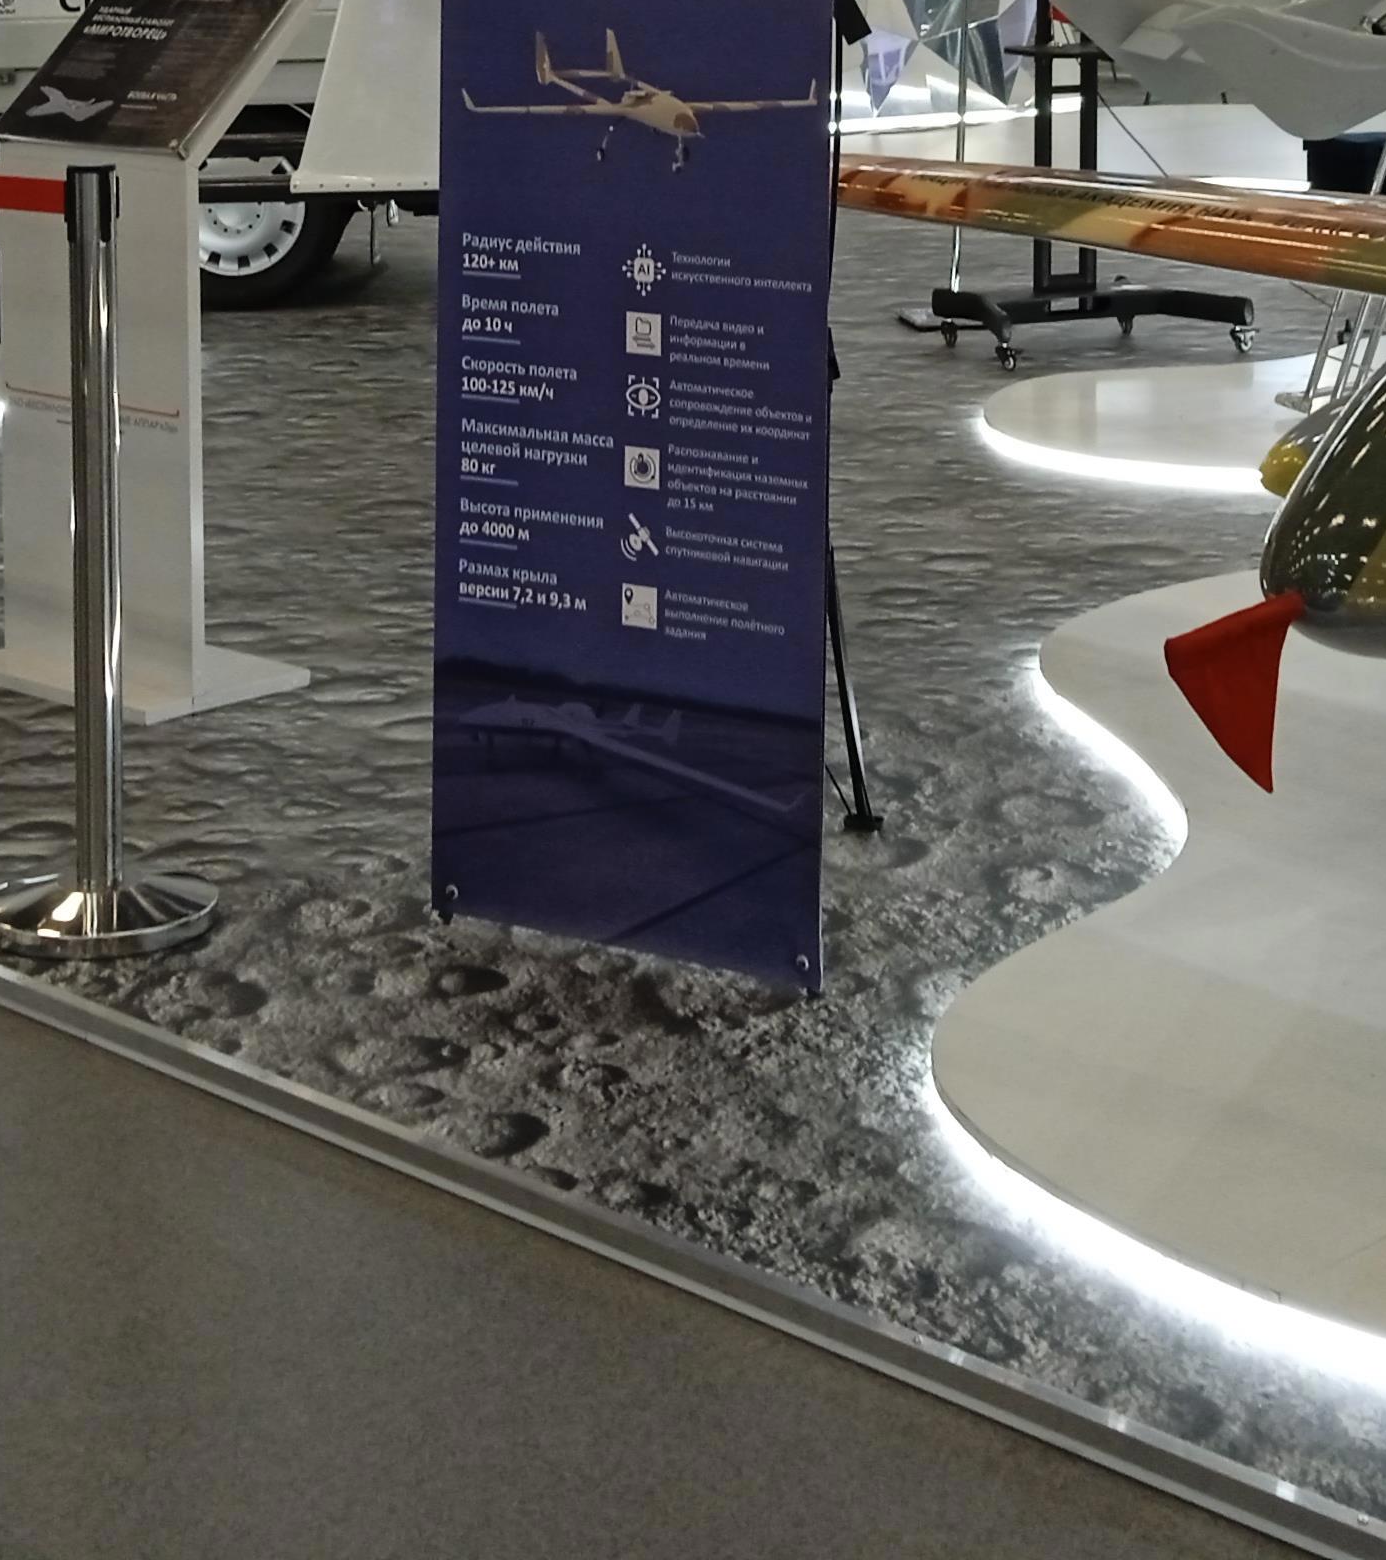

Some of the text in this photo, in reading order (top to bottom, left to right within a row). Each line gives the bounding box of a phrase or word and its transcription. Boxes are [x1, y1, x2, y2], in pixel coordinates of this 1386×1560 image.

[83, 24, 168, 41] «МИРОТВОРЕЦ»
[462, 232, 581, 256] Радиус действия
[463, 253, 519, 272] 120+ км
[637, 263, 651, 274] AI
[671, 251, 731, 268] Технологии
[671, 272, 813, 293] искусственного интеллекта
[462, 294, 559, 317] Время полета
[462, 317, 513, 333] до 10 ч
[669, 315, 765, 336] Передача видео и
[669, 333, 746, 351] информации в
[461, 355, 578, 381] Скорость полета
[669, 352, 770, 371] реальном времени
[461, 376, 554, 402] 100-125 км/ч
[669, 379, 754, 399] Автоматическое
[669, 399, 813, 423] сопровождение объектов и
[461, 417, 614, 448] Максимальная масса
[669, 417, 810, 441] определение их координат
[461, 440, 588, 467] целевой нагрузки
[668, 444, 759, 465] Распознавание и
[461, 458, 496, 476] 80 кг
[667, 463, 808, 489] идентификация наземных
[667, 479, 797, 505] объектов на расстоянии
[460, 497, 604, 529] Высота применения
[666, 498, 714, 512] до 15 км
[459, 520, 530, 541] до 4000 м
[665, 526, 784, 554] Высокоточная система
[665, 546, 789, 571] спутниковой навигации
[458, 558, 558, 586] Размах крыла
[459, 582, 587, 611] версии 7,2 и 9,3 м
[664, 589, 749, 612] Автоматическое
[664, 609, 786, 636] выполнение полётного
[664, 626, 707, 640] задания
